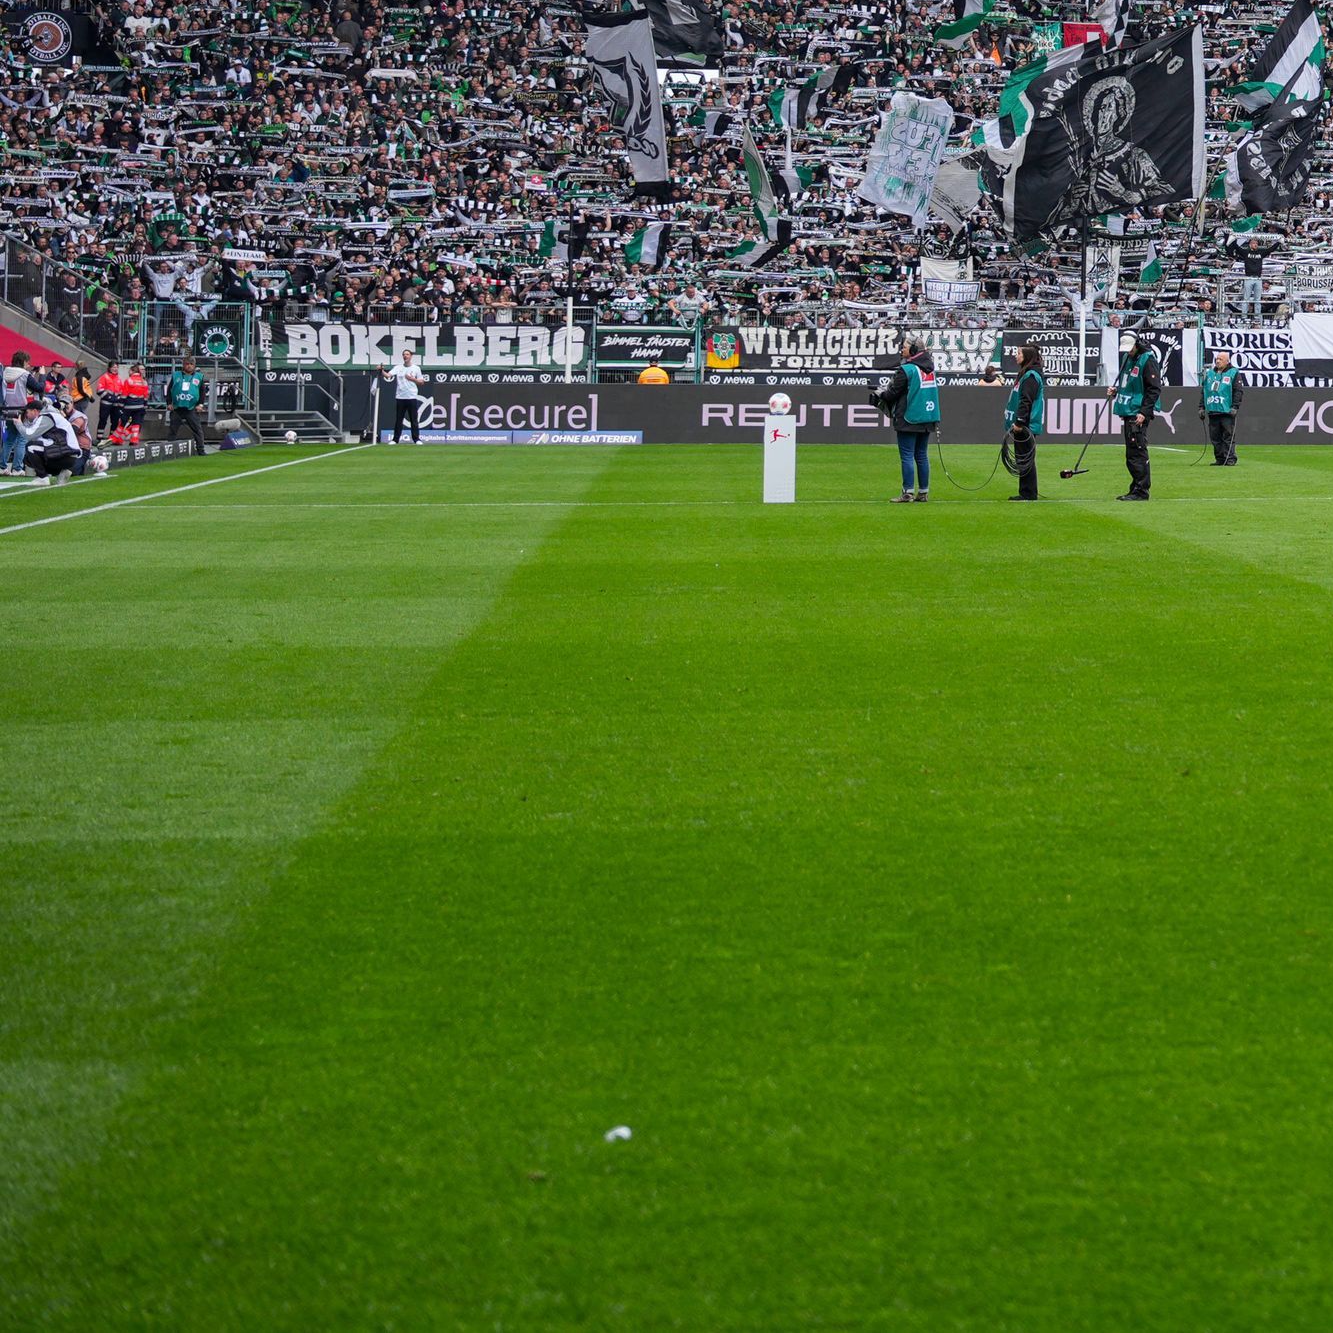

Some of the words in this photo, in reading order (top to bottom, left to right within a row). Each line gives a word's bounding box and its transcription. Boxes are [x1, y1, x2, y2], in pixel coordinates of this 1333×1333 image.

[1097, 237, 1149, 248] FREUNDE
[284, 324, 587, 366] BOKELBERG
[600, 334, 644, 347] BIMMEL
[738, 327, 901, 357] WILLICHER
[905, 330, 998, 352] VITUS
[1209, 332, 1294, 348] BORUSS
[631, 348, 664, 359] HAMM
[770, 356, 874, 370] FOHLEN
[932, 352, 991, 373] REW
[453, 374, 482, 382] mewa
[503, 374, 534, 383] mewa
[553, 375, 586, 384] mwa
[724, 375, 755, 384] mewa
[781, 375, 812, 385] mewa
[837, 376, 868, 386] mewa
[948, 377, 980, 386] mewa
[445, 434, 508, 444] Zutrittsmanagement
[551, 434, 580, 444] OHNE
[581, 434, 637, 444] BATTERIEN
